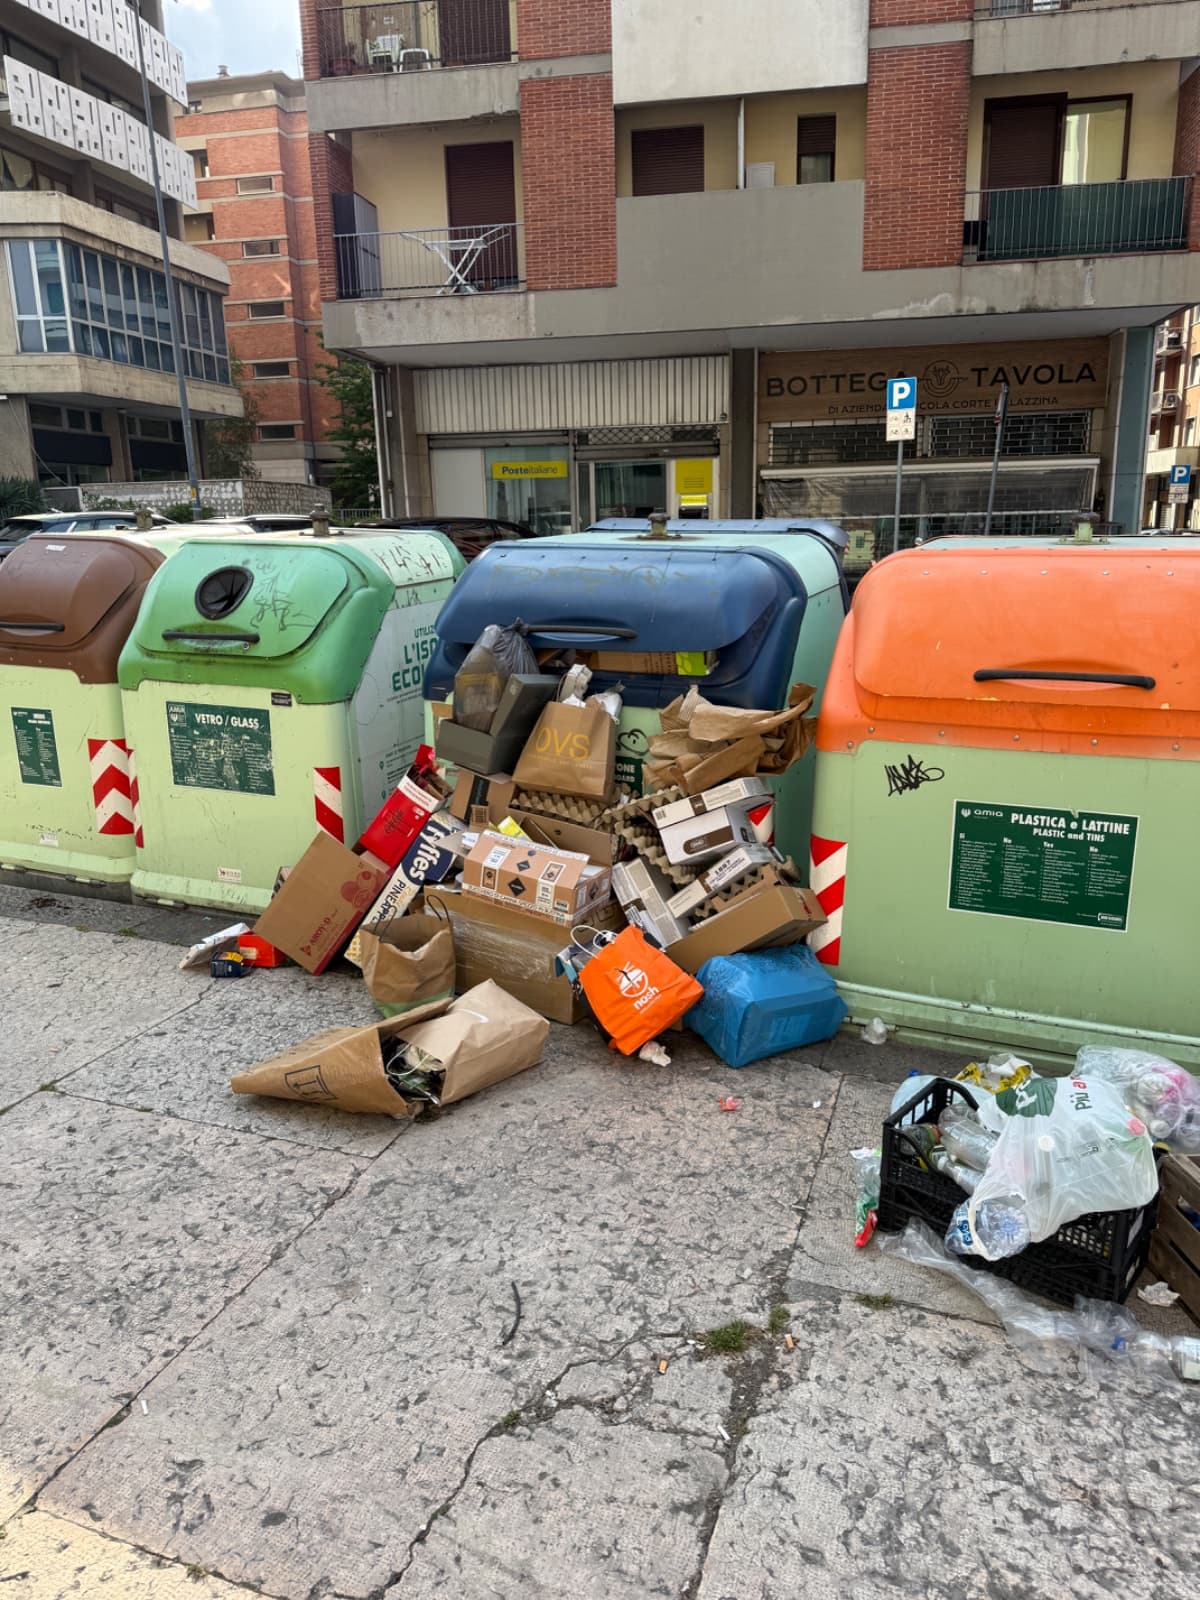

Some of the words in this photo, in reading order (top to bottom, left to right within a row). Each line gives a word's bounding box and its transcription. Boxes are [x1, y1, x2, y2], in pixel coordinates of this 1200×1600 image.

[972, 362, 1097, 388] TAVOLA
[893, 382, 911, 408] P
[828, 405, 840, 415] DI
[953, 399, 991, 410] CORTE
[1174, 466, 1187, 482] P
[194, 713, 223, 725] VETRO
[230, 716, 260, 729] GLASS
[535, 725, 591, 761] OVS
[616, 763, 635, 773] ONE
[974, 808, 1004, 818] amia
[1010, 812, 1066, 829] PLASTICA
[1070, 820, 1078, 830] e
[1082, 819, 1131, 835] LATTINE
[1032, 828, 1065, 839] PLASTIC
[1067, 831, 1083, 841] and
[1086, 833, 1105, 843] TINS
